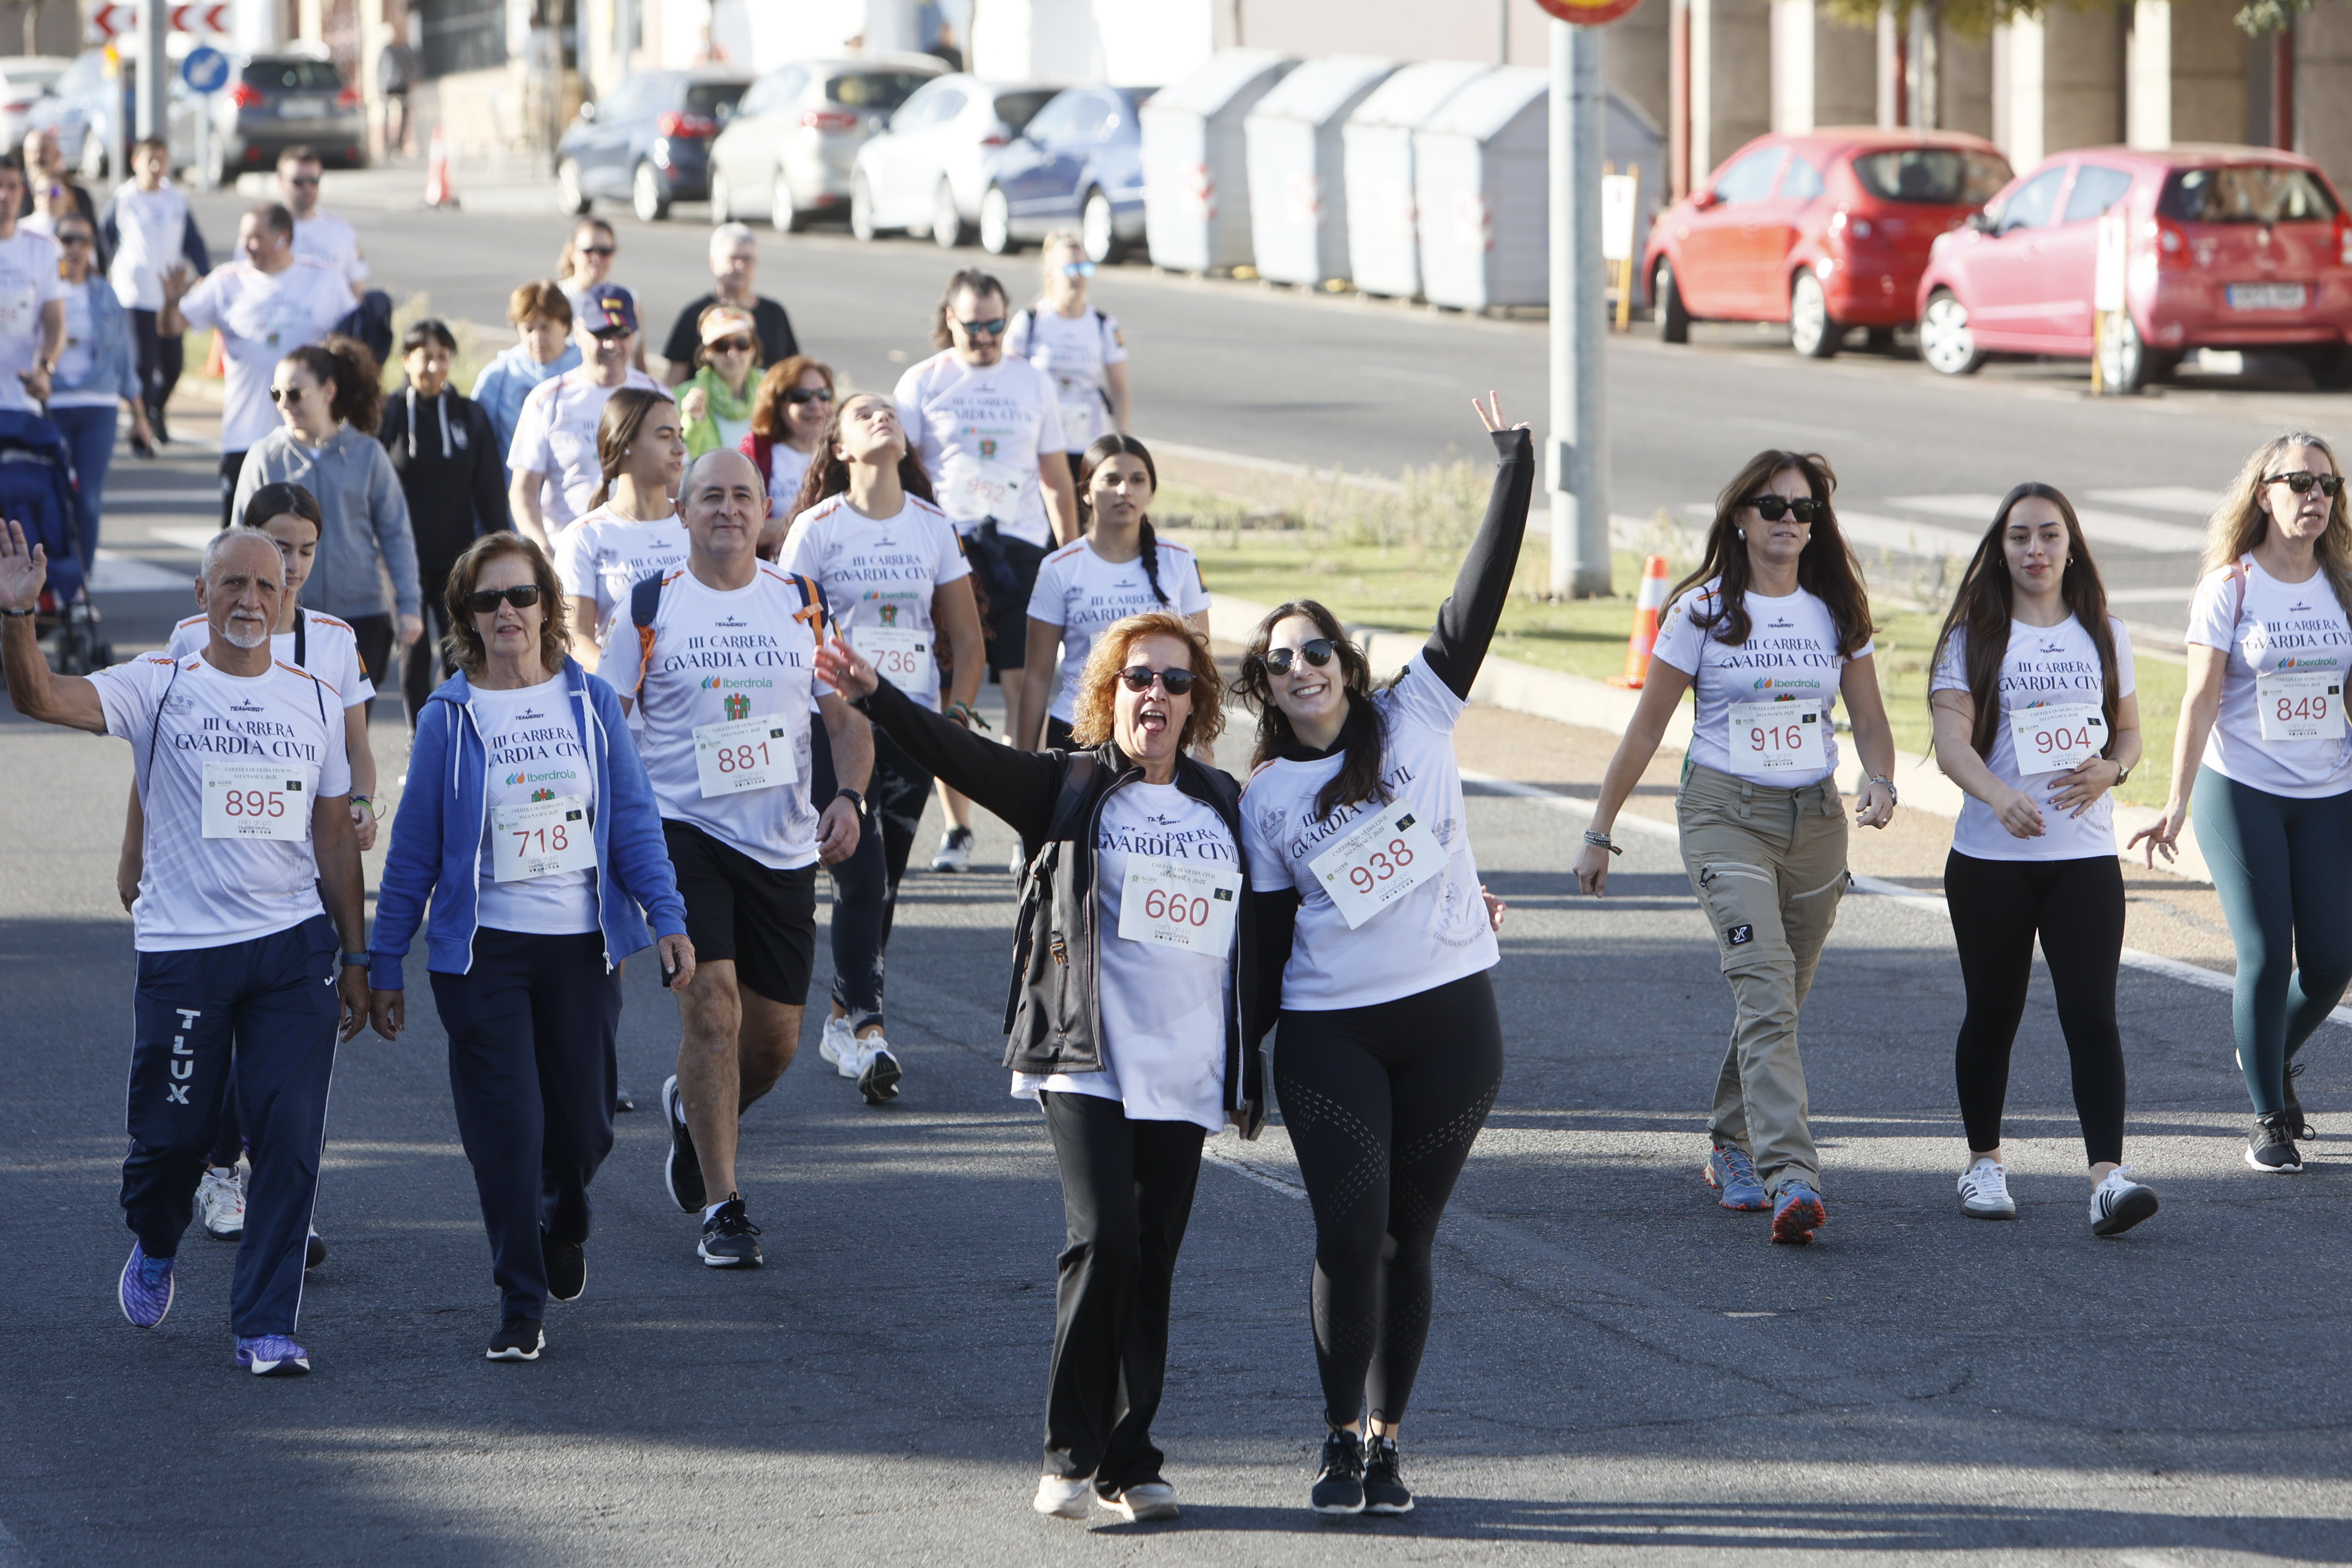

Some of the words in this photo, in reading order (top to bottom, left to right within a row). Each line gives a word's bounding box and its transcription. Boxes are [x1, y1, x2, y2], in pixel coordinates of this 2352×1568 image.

[853, 556, 865, 566] III
[870, 554, 922, 566] CARRERA
[835, 567, 900, 582] GVARDIA
[1091, 596, 1103, 606] III
[2267, 620, 2281, 632] III
[2285, 619, 2340, 631] CARRERA
[688, 636, 704, 649] III
[710, 634, 778, 648] CARRERA
[1744, 639, 1758, 650] III
[1763, 638, 1821, 651] CARRERA
[2246, 633, 2318, 650] GVARDIA
[2323, 632, 2352, 646] CIVI
[664, 651, 747, 672] GVARDIA
[754, 650, 804, 668] CIVIL
[871, 649, 916, 674] 736
[1720, 653, 1798, 669] GVARDIA
[1803, 654, 1840, 670] CIVIL
[2018, 662, 2031, 673] III
[2036, 661, 2094, 674] CARRERA
[2297, 657, 2337, 667] Iberdrola
[723, 677, 772, 689] Iberdrola
[1774, 678, 1820, 688] Iberdrola
[1998, 676, 2067, 692] GVARDIA
[2074, 676, 2103, 693] CIVI
[2276, 696, 2327, 721] 849
[203, 717, 220, 731] III
[226, 719, 295, 738] CARRERA
[493, 734, 507, 749] III
[511, 727, 575, 744] CARRERA
[1751, 725, 1802, 751] 916
[2035, 726, 2092, 754] 904
[175, 734, 266, 755] GVARDIA
[273, 741, 318, 763] CIVIL
[489, 744, 550, 768] VARDIA
[718, 741, 770, 773] 881
[527, 769, 576, 783] Iberdrola
[225, 790, 285, 818] 895
[1375, 815, 1388, 826] CIVIL
[1291, 803, 1364, 859] GVARDIA
[512, 824, 569, 858] 718
[1344, 835, 1373, 858] SALAMANCA
[1374, 826, 1385, 838] 2025
[1198, 842, 1239, 864] CIVIL
[528, 861, 559, 869] EMPRESARIAL
[1152, 862, 1176, 872] CARRERA
[1334, 862, 1349, 874] ALCER
[1349, 838, 1414, 894] 938
[1376, 884, 1390, 895] nani
[1390, 871, 1409, 888] grupo
[1379, 876, 1412, 900] EMPRESARIAL
[1145, 888, 1209, 927] 660
[1155, 930, 1190, 940] EMPRESARIAL
[1172, 926, 1191, 936] grupo
[1433, 932, 1468, 947] COMANDANCIA
